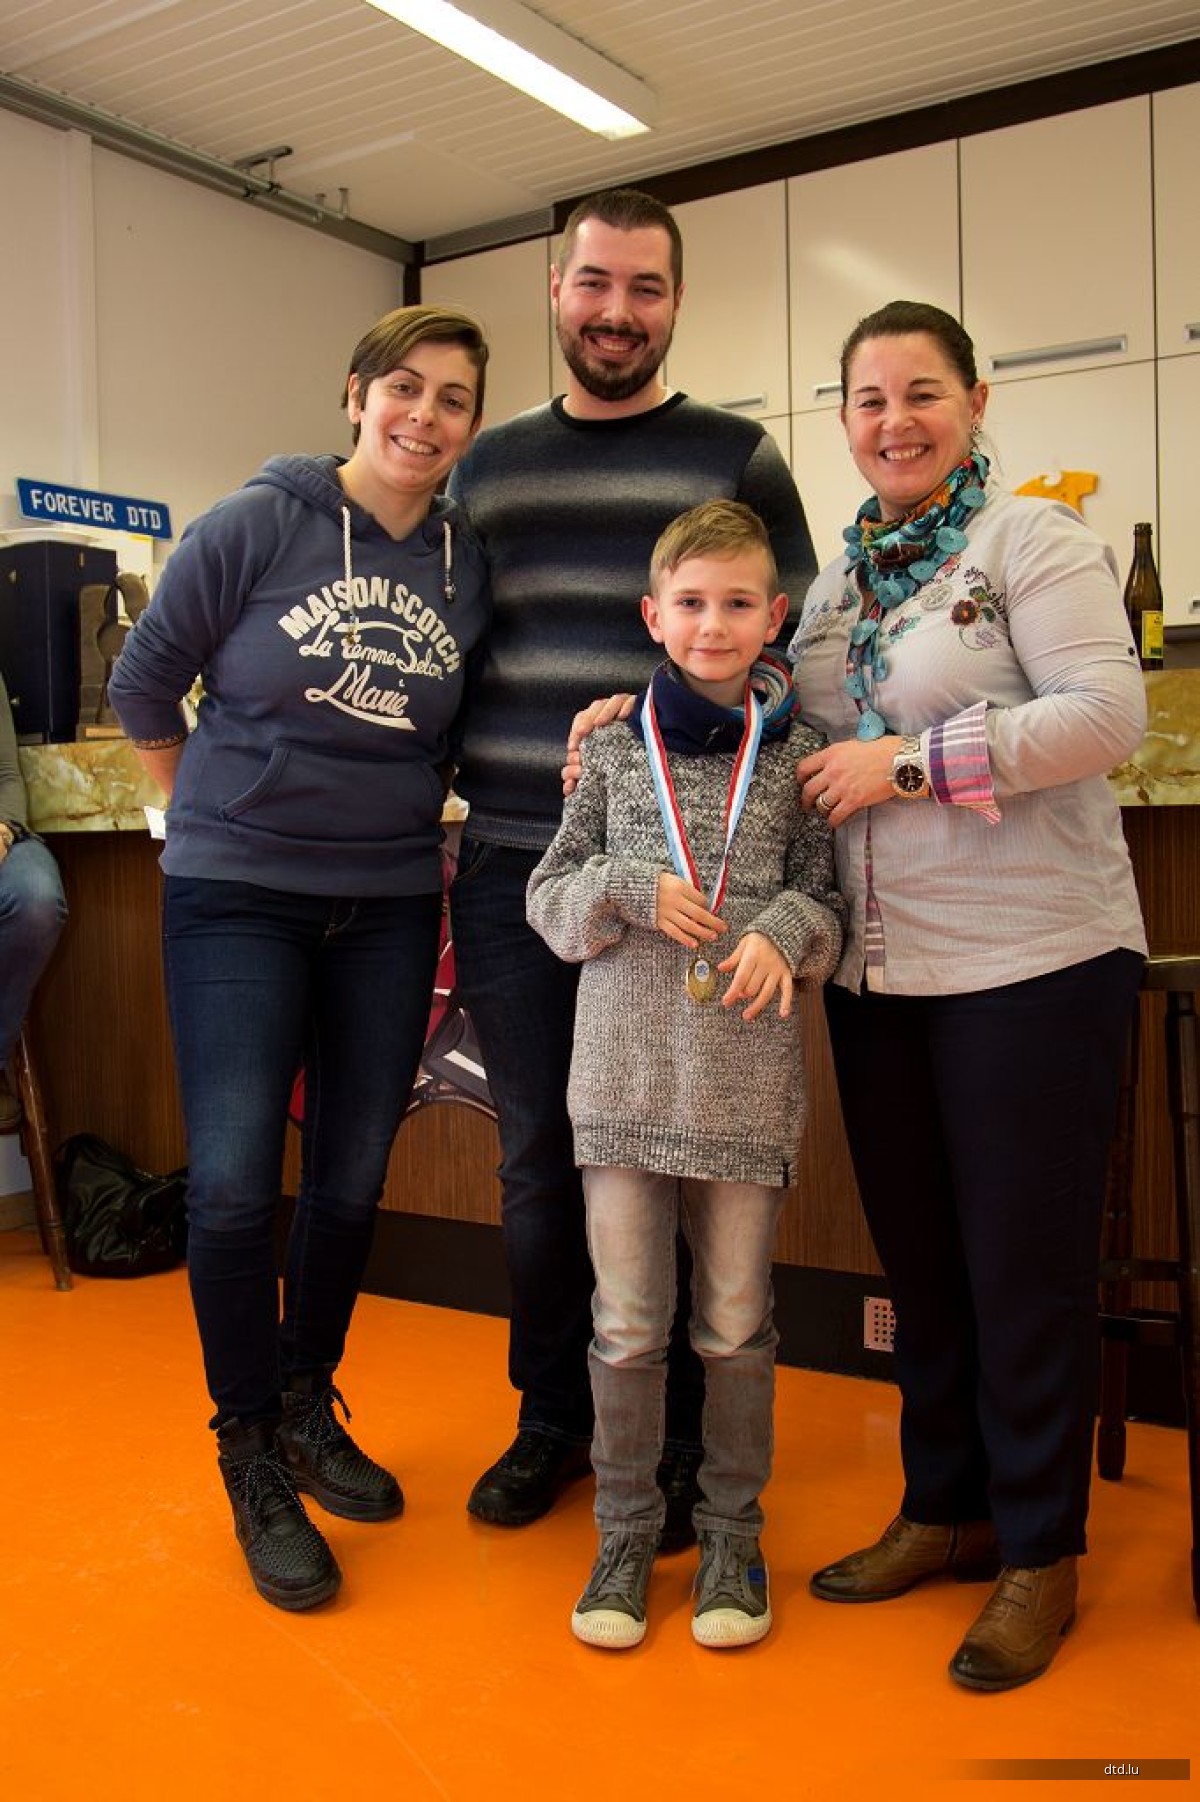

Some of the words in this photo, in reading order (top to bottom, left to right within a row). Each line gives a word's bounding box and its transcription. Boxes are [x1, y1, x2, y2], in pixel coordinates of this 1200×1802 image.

[30, 488, 116, 523] FOREVER
[126, 506, 161, 530] DTD
[278, 576, 389, 640] MAISON
[390, 583, 460, 673] SCOTCH
[299, 611, 340, 657] La
[396, 629, 444, 680] Selon
[304, 661, 416, 731] Marie
